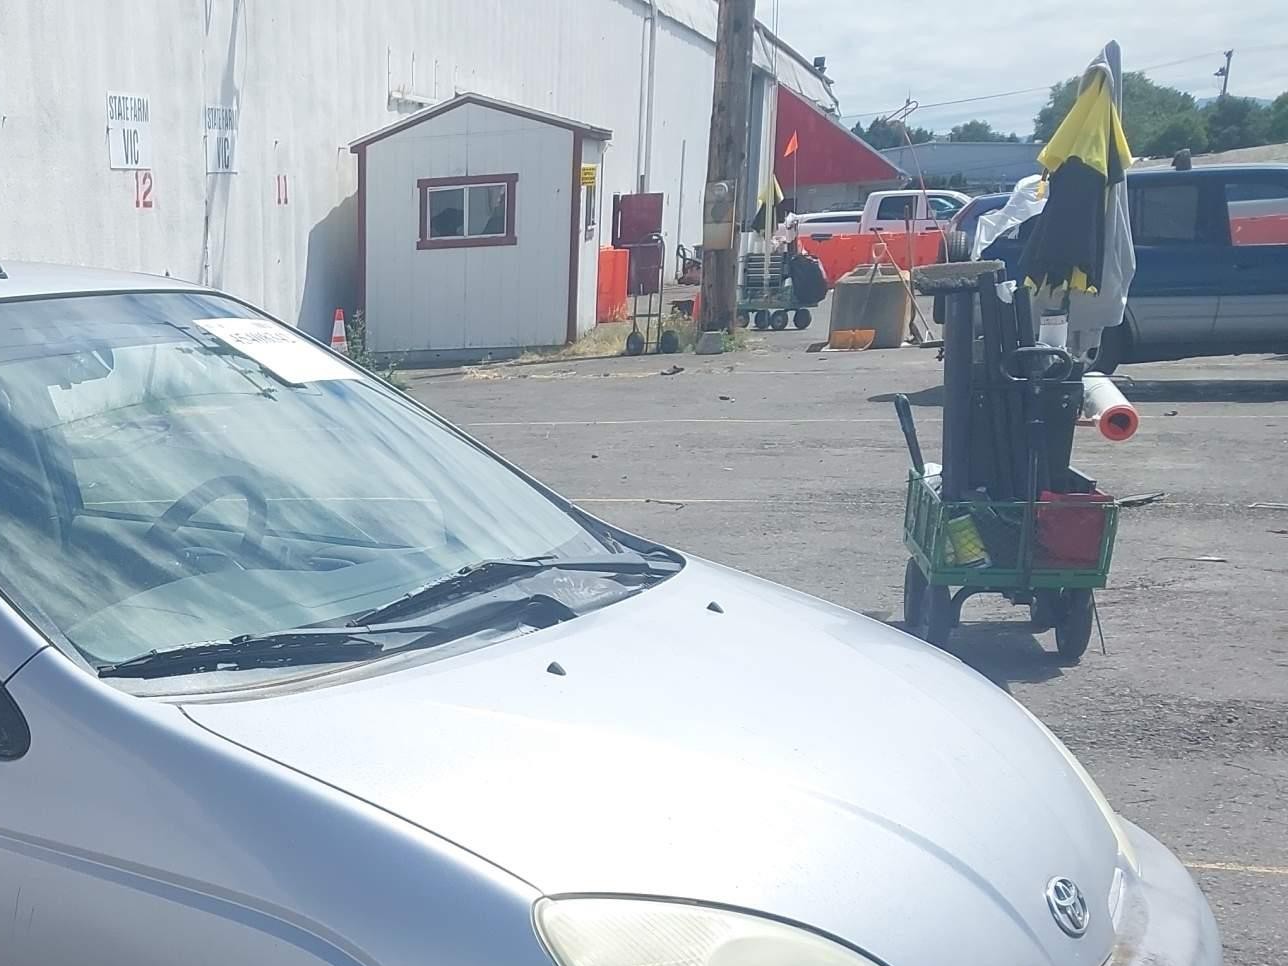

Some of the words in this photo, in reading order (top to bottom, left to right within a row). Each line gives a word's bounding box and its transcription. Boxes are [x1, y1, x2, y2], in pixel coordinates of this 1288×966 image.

[109, 95, 129, 121] STATE
[130, 97, 149, 122] FARM
[122, 127, 139, 165] VIC
[216, 136, 230, 169] VIC
[135, 171, 153, 208] 12
[277, 174, 288, 205] 11
